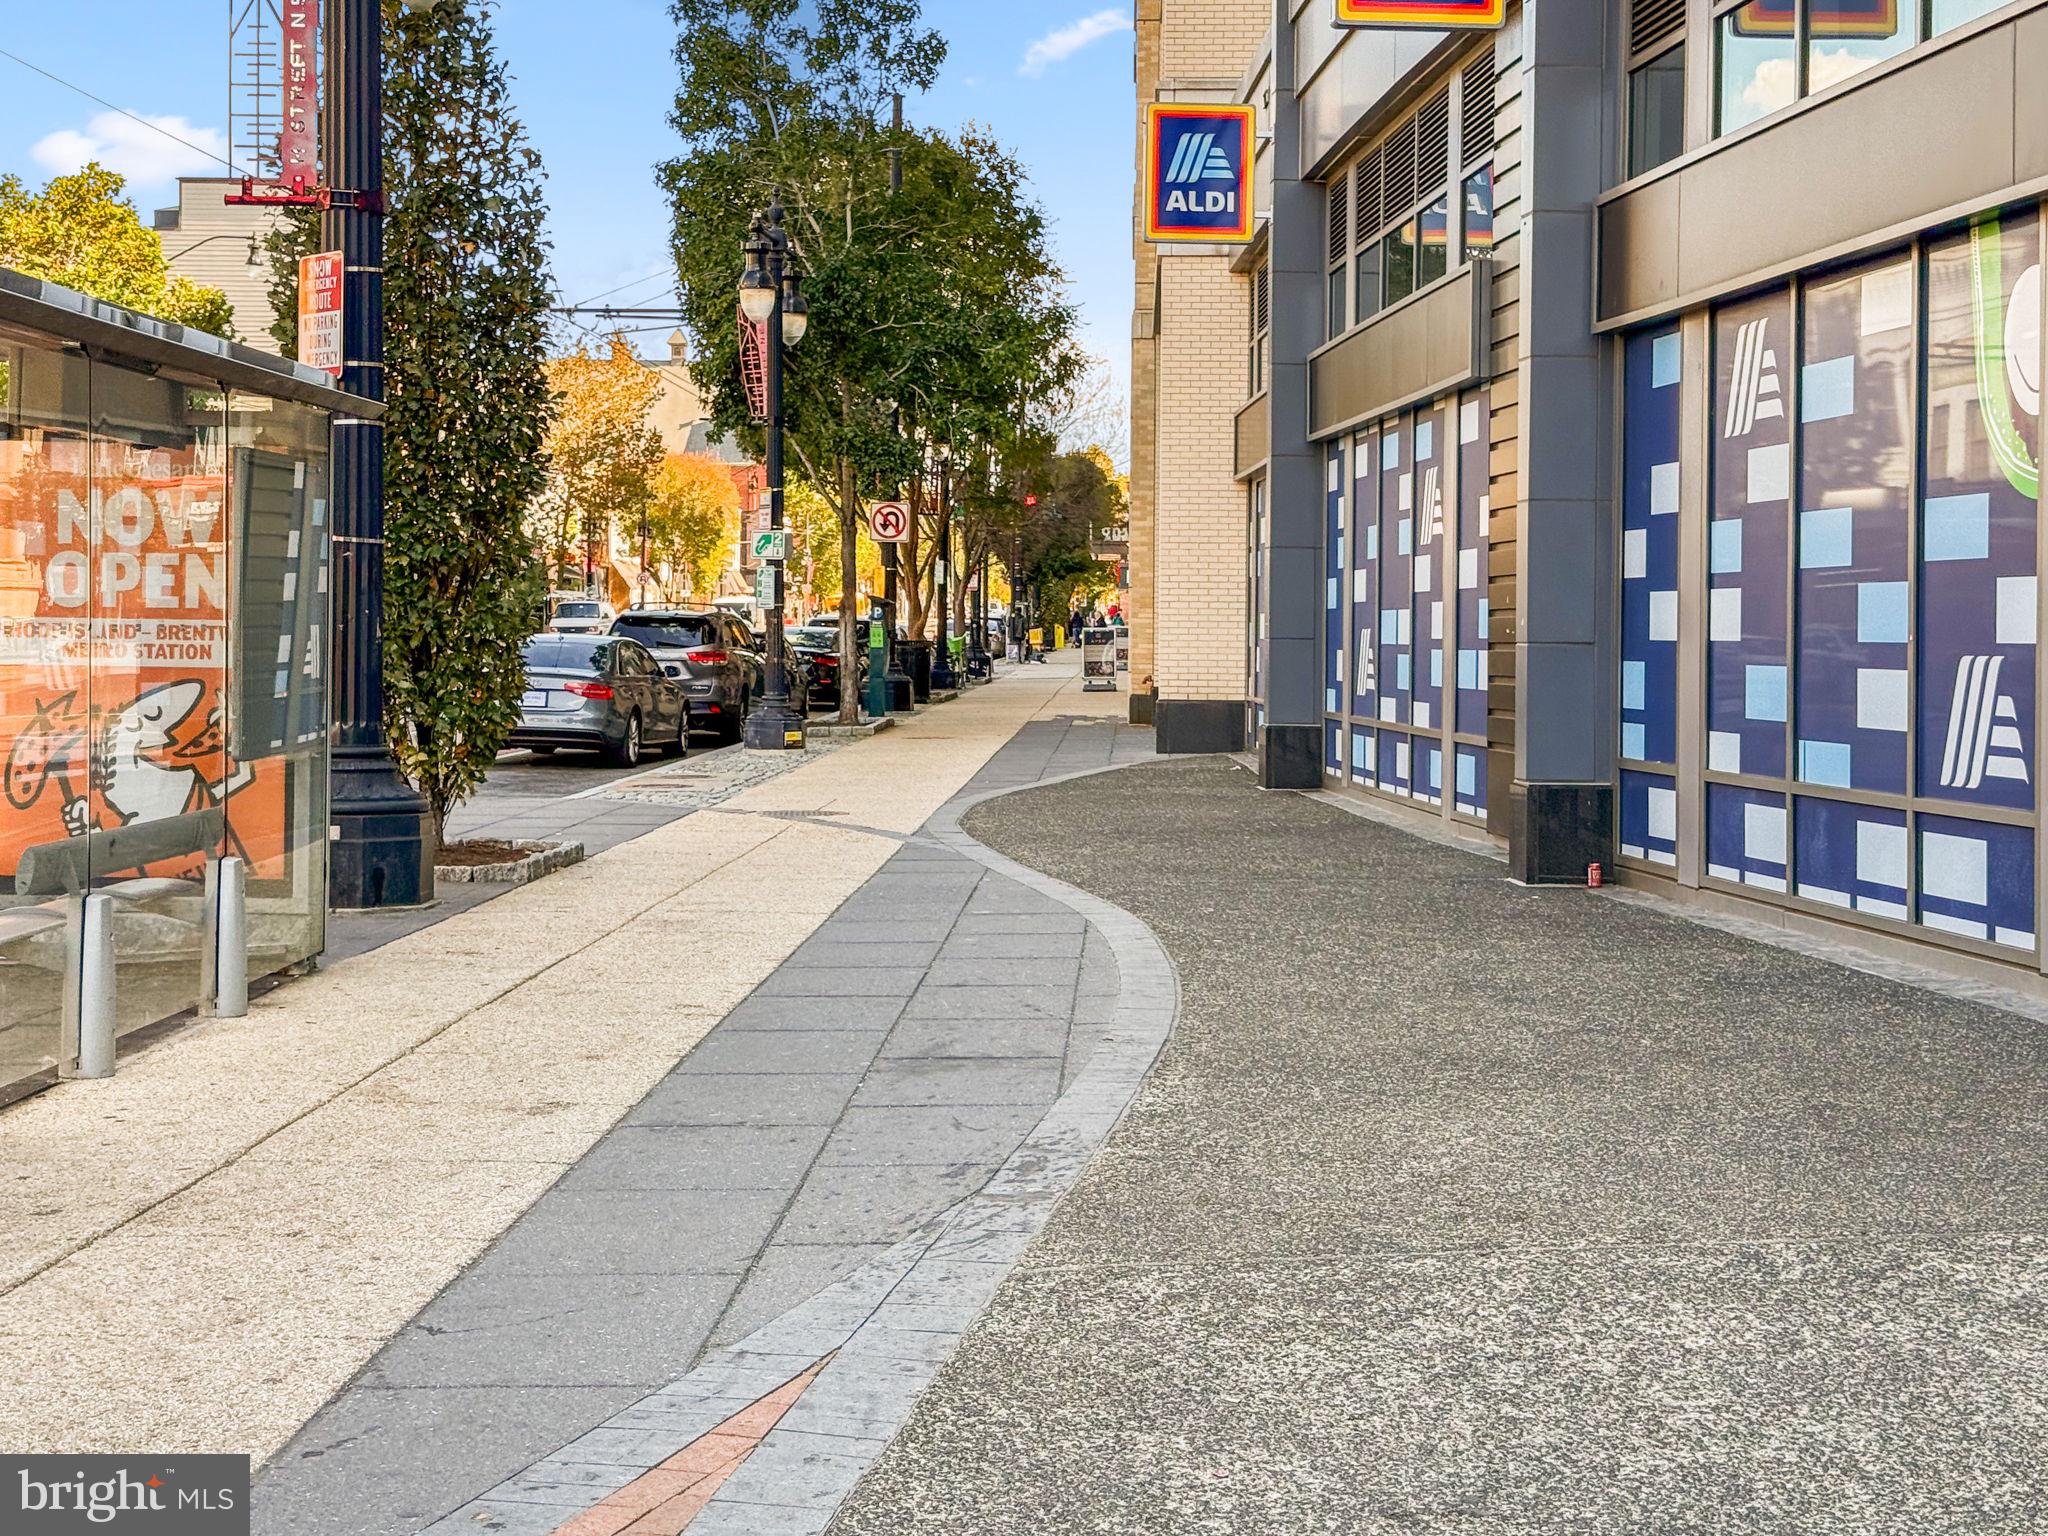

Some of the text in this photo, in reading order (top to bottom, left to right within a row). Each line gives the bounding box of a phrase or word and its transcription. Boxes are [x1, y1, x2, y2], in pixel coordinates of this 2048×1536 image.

[1166, 190, 1234, 213] ALDI
[308, 259, 333, 278] SNOW
[305, 276, 338, 291] EMERGENCY
[309, 292, 332, 310] ROUTE
[314, 313, 338, 331] PARKING
[309, 333, 332, 350] DURING
[57, 487, 221, 547] NOW
[774, 533, 783, 544] 2
[47, 551, 224, 609] OPEN
[873, 606, 883, 619] P
[135, 643, 212, 660] STATION
